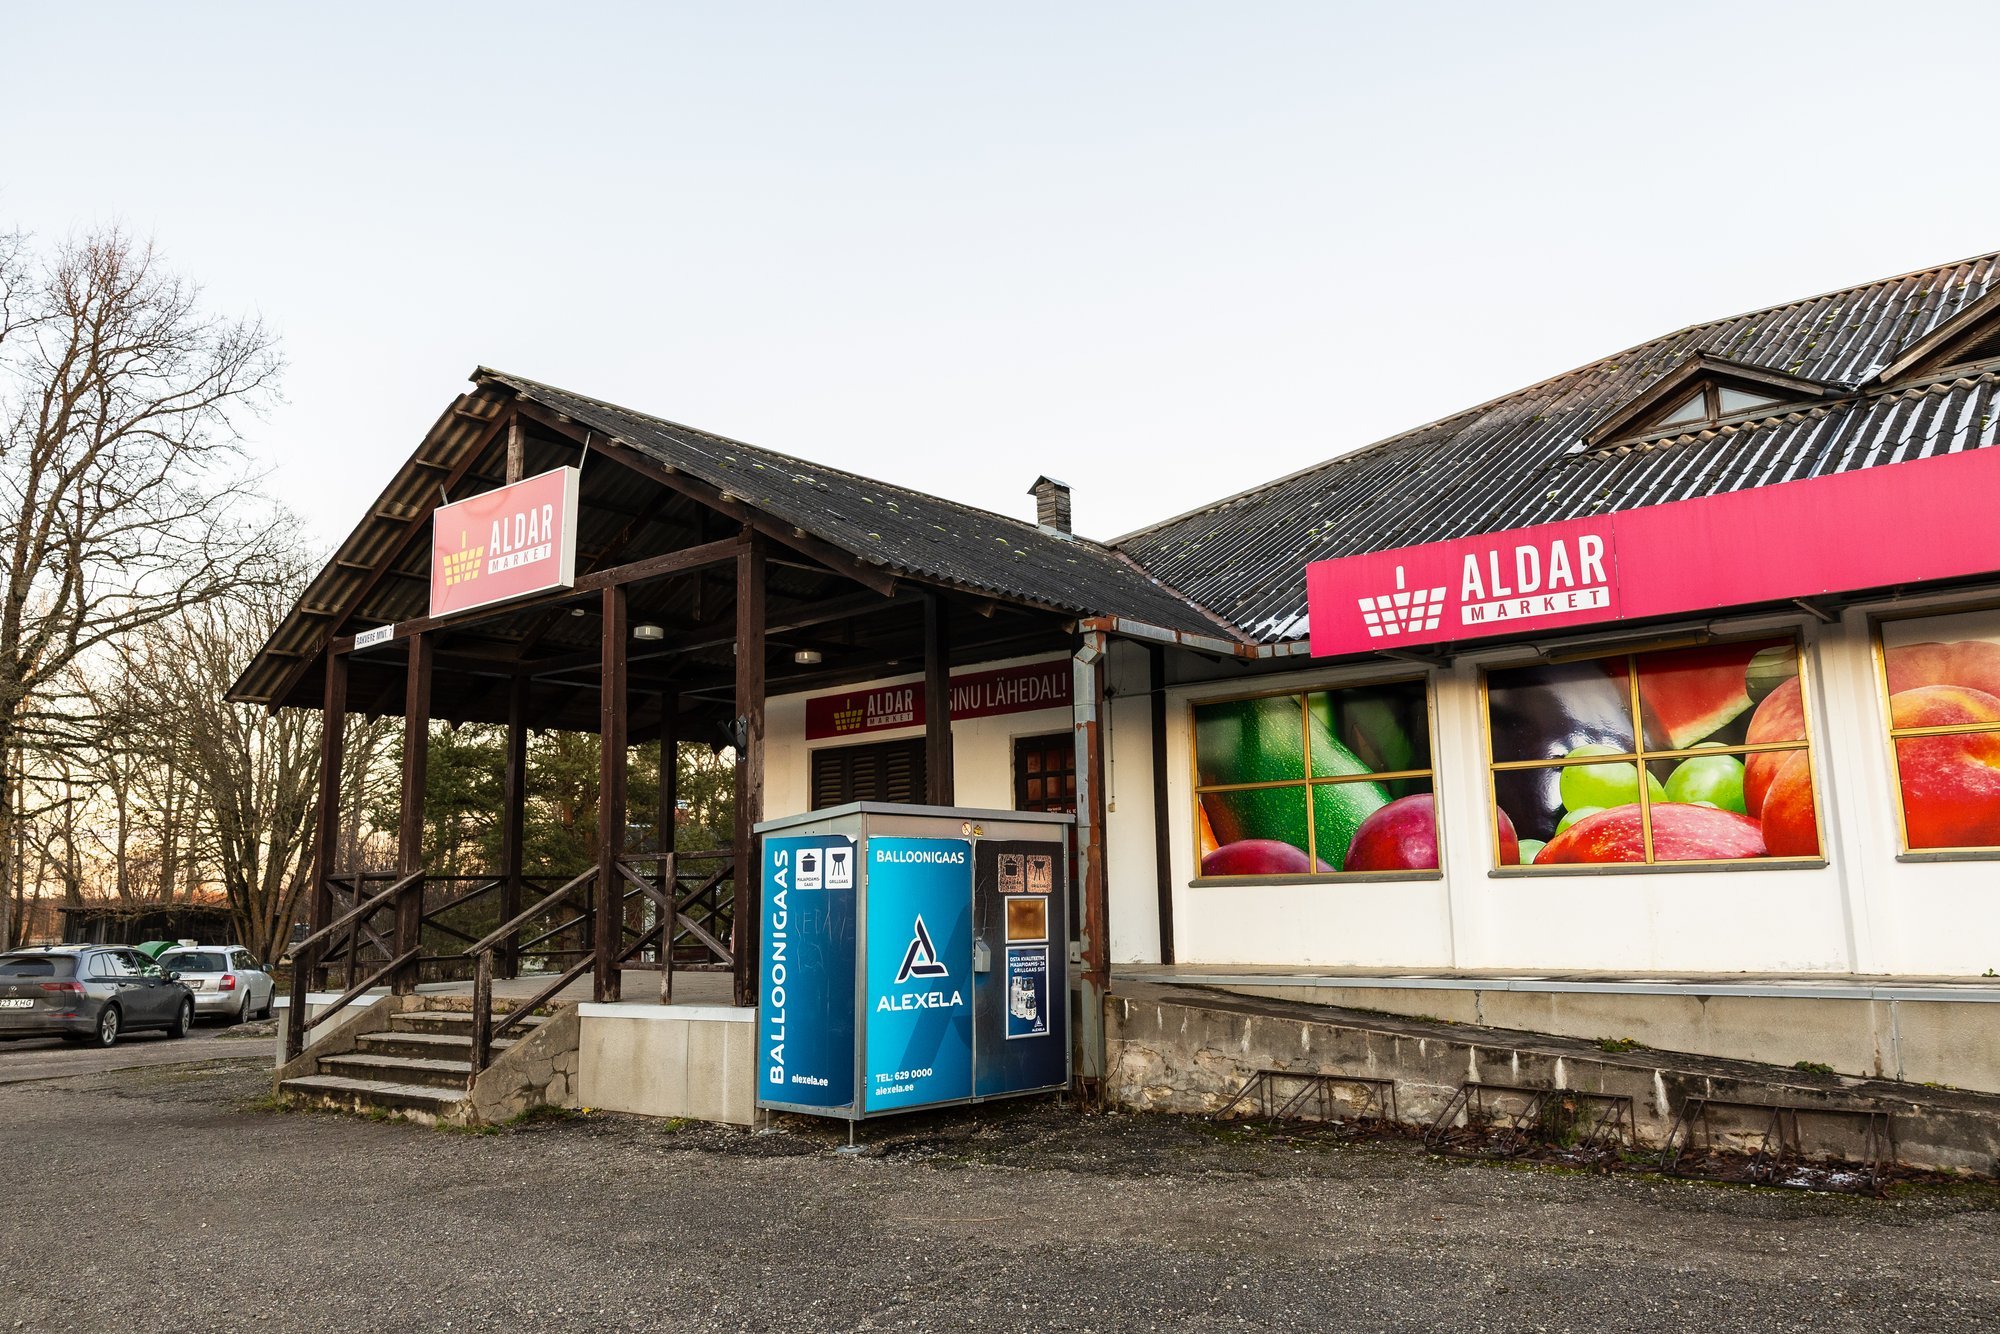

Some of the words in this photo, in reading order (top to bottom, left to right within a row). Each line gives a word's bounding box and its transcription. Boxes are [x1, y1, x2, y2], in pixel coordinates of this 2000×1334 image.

[489, 504, 553, 557] ALDAR
[491, 546, 549, 571] MARKET
[1461, 534, 1607, 601] ALDAR
[1470, 590, 1601, 621] MARKET
[867, 688, 914, 716] ALDAR
[986, 672, 1067, 708] LÄHEDAL!
[869, 713, 912, 725] MARKET
[876, 850, 965, 864] BALLOONIGAAS
[769, 849, 789, 1085] BALLOONIGAAS
[13, 999, 32, 1007] XHG
[876, 990, 963, 1012] ALEXELA
[791, 1073, 829, 1087] alexela.ee
[875, 1073, 893, 1083] TEL:
[894, 1070, 910, 1081] 629
[911, 1067, 933, 1079] 0000
[875, 1083, 915, 1096] alexela.ee
